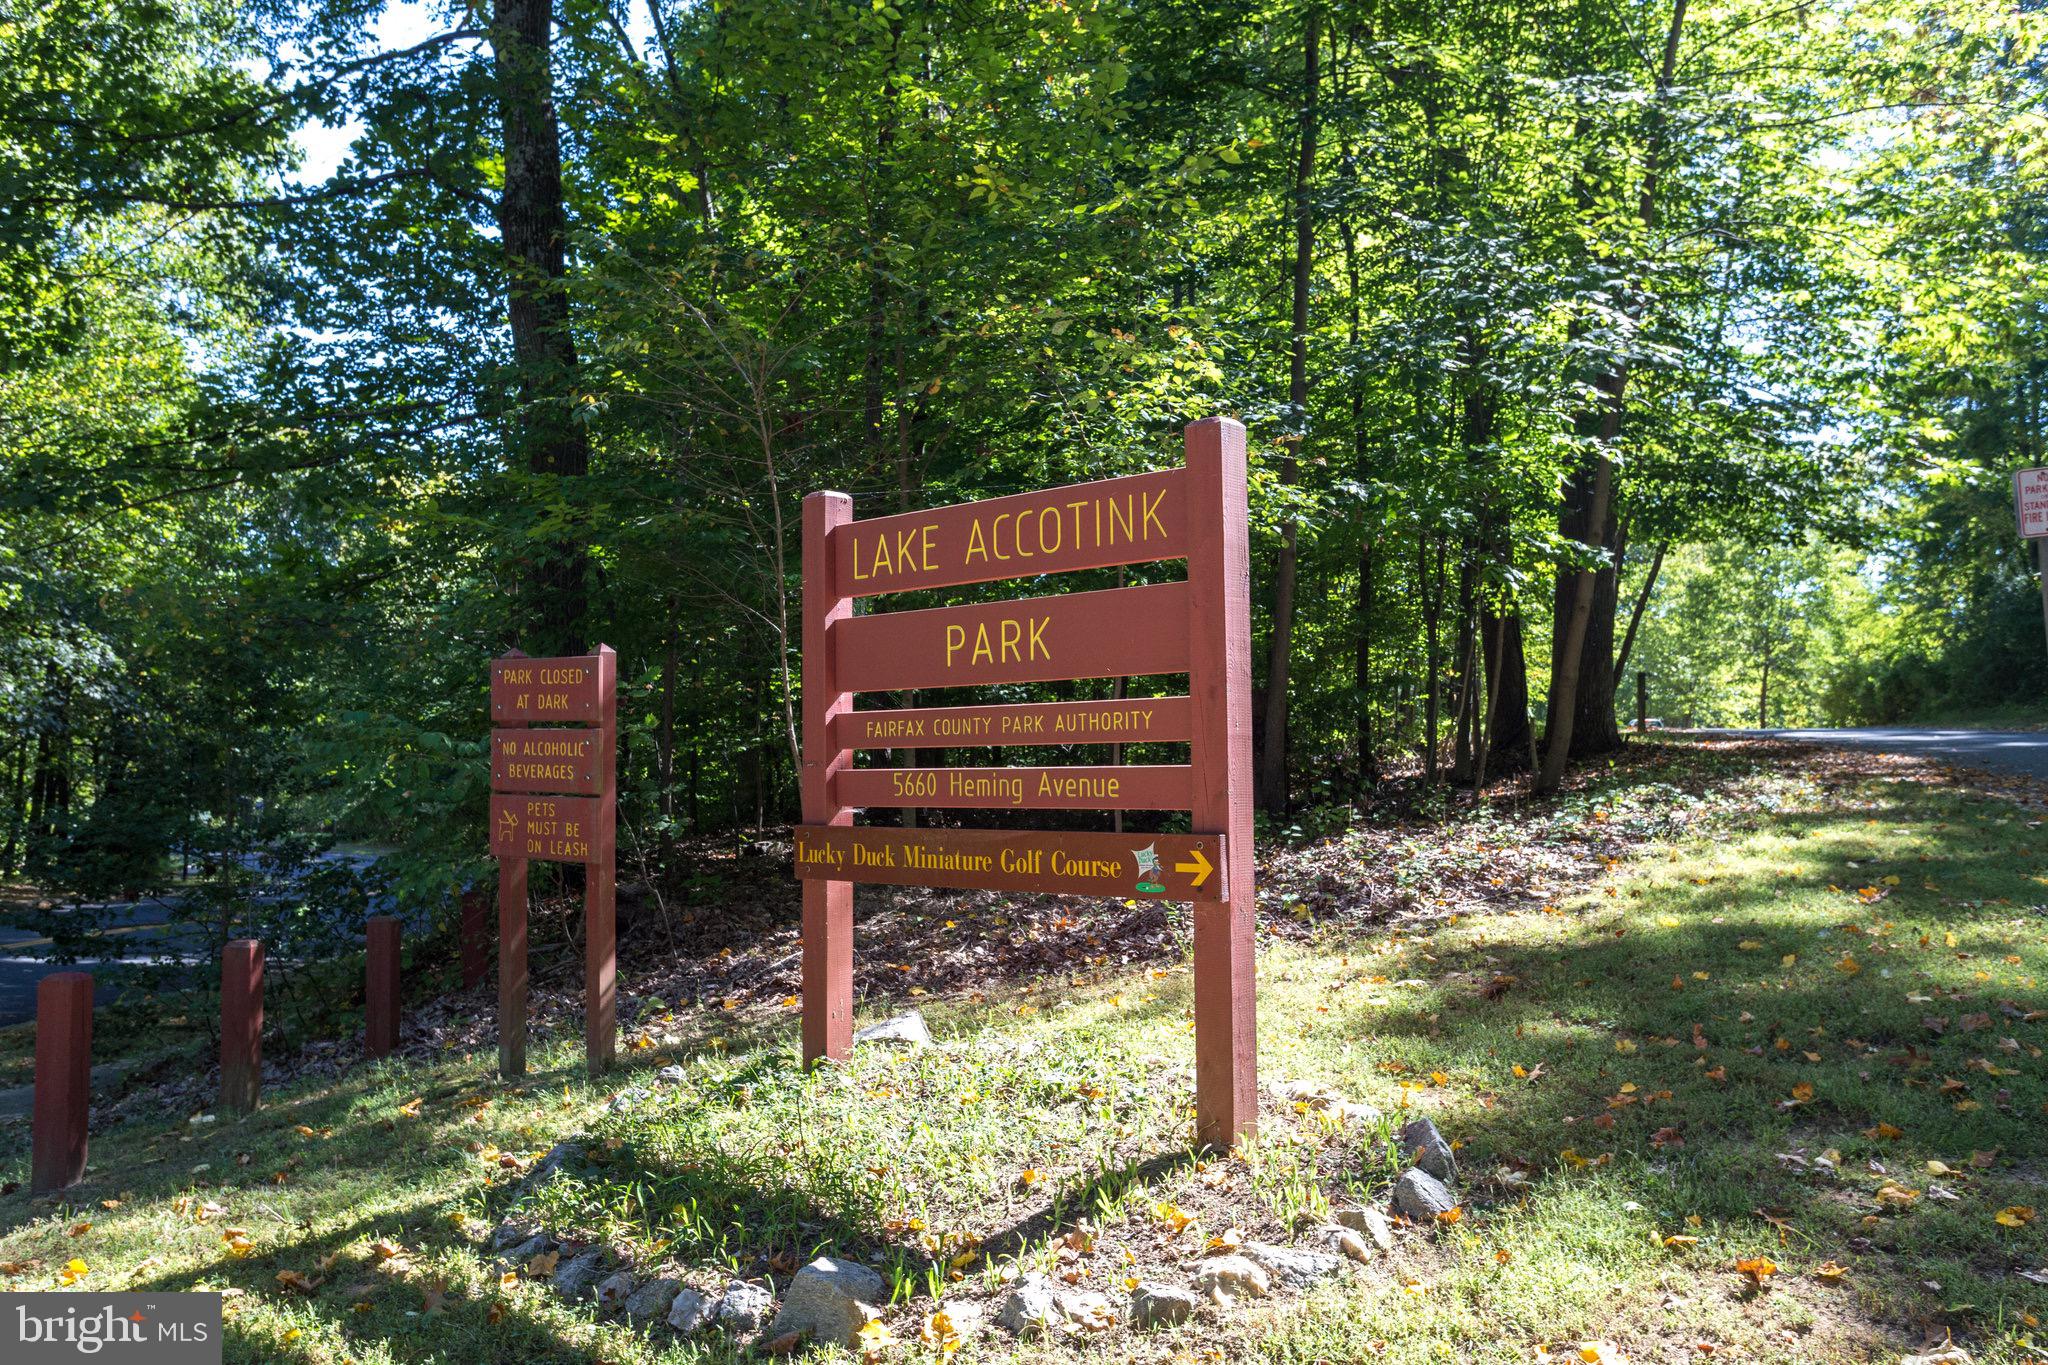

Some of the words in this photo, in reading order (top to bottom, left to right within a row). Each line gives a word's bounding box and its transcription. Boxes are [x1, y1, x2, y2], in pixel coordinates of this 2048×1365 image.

[2024, 511, 2043, 524] FIRE
[853, 524, 940, 581] LAKE
[965, 488, 1168, 565] ACCOTINK
[946, 616, 1051, 668] PARK
[504, 669, 533, 684] PARK
[540, 669, 583, 684] CLOSED
[516, 694, 530, 709] AT
[538, 694, 569, 709] DARK
[866, 719, 925, 739] FAIRFAX
[933, 716, 992, 736] COUNTY
[1002, 715, 1044, 733] PARK
[1055, 710, 1153, 732] AUTHORITY
[502, 742, 517, 756] NO
[523, 741, 585, 757] ALCOHOLIC
[509, 764, 574, 780] BEVERAGES
[893, 772, 937, 798] 5660
[950, 772, 1023, 804] Heming
[1038, 771, 1120, 798] Avenue
[527, 802, 555, 817] PETS
[527, 821, 557, 836] MUST
[565, 822, 580, 838] BE
[527, 839, 542, 854] ON
[550, 841, 588, 857] LEASH
[799, 841, 846, 872] Lucky
[853, 843, 895, 867] Duck
[903, 845, 993, 872] Miniature
[1000, 848, 1043, 875] Golf
[1051, 850, 1122, 878] Course
